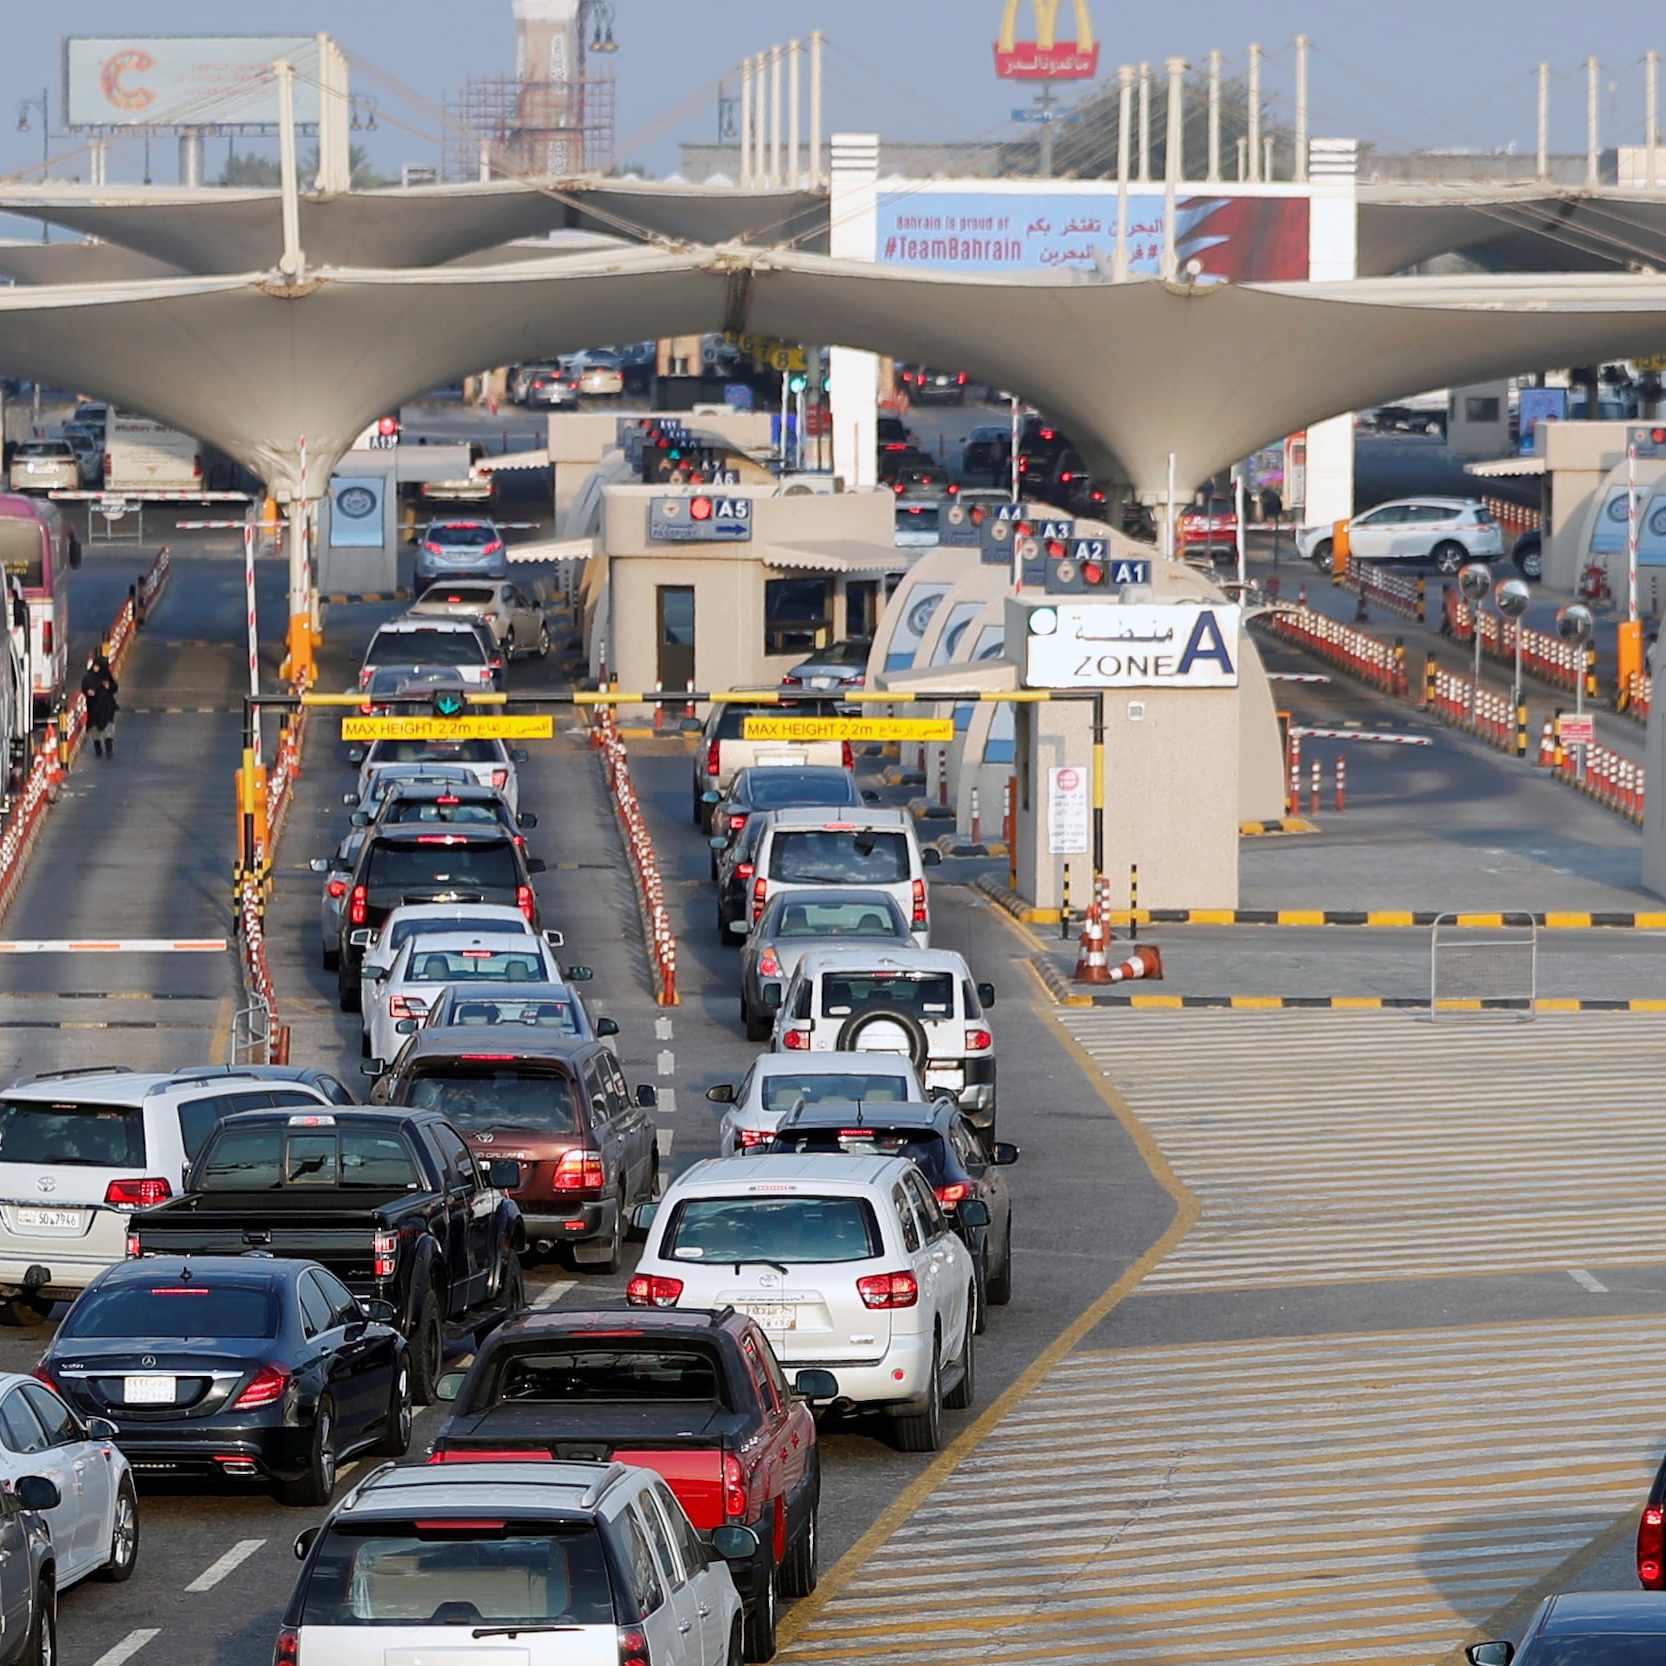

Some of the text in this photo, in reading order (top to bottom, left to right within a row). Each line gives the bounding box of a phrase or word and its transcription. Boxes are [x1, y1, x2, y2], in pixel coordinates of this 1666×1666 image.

[896, 215, 1010, 232] Bahrain is proud of
[1108, 218, 1164, 237] البحرن
[884, 236, 1023, 261] #TeamBahrain
[712, 472, 735, 486] A6
[717, 500, 748, 519] A5
[998, 506, 1023, 520] A4
[1042, 523, 1070, 539] A3
[1074, 541, 1103, 560] A2
[1115, 565, 1144, 584] A1
[1073, 609, 1235, 678] ZONE A
[345, 722, 375, 736] MAX
[379, 722, 434, 736] HEIGHT
[438, 722, 472, 736] 2.2m
[747, 722, 776, 736] MAX
[780, 722, 835, 736] HEIGHT
[838, 722, 873, 736] 2.2m
